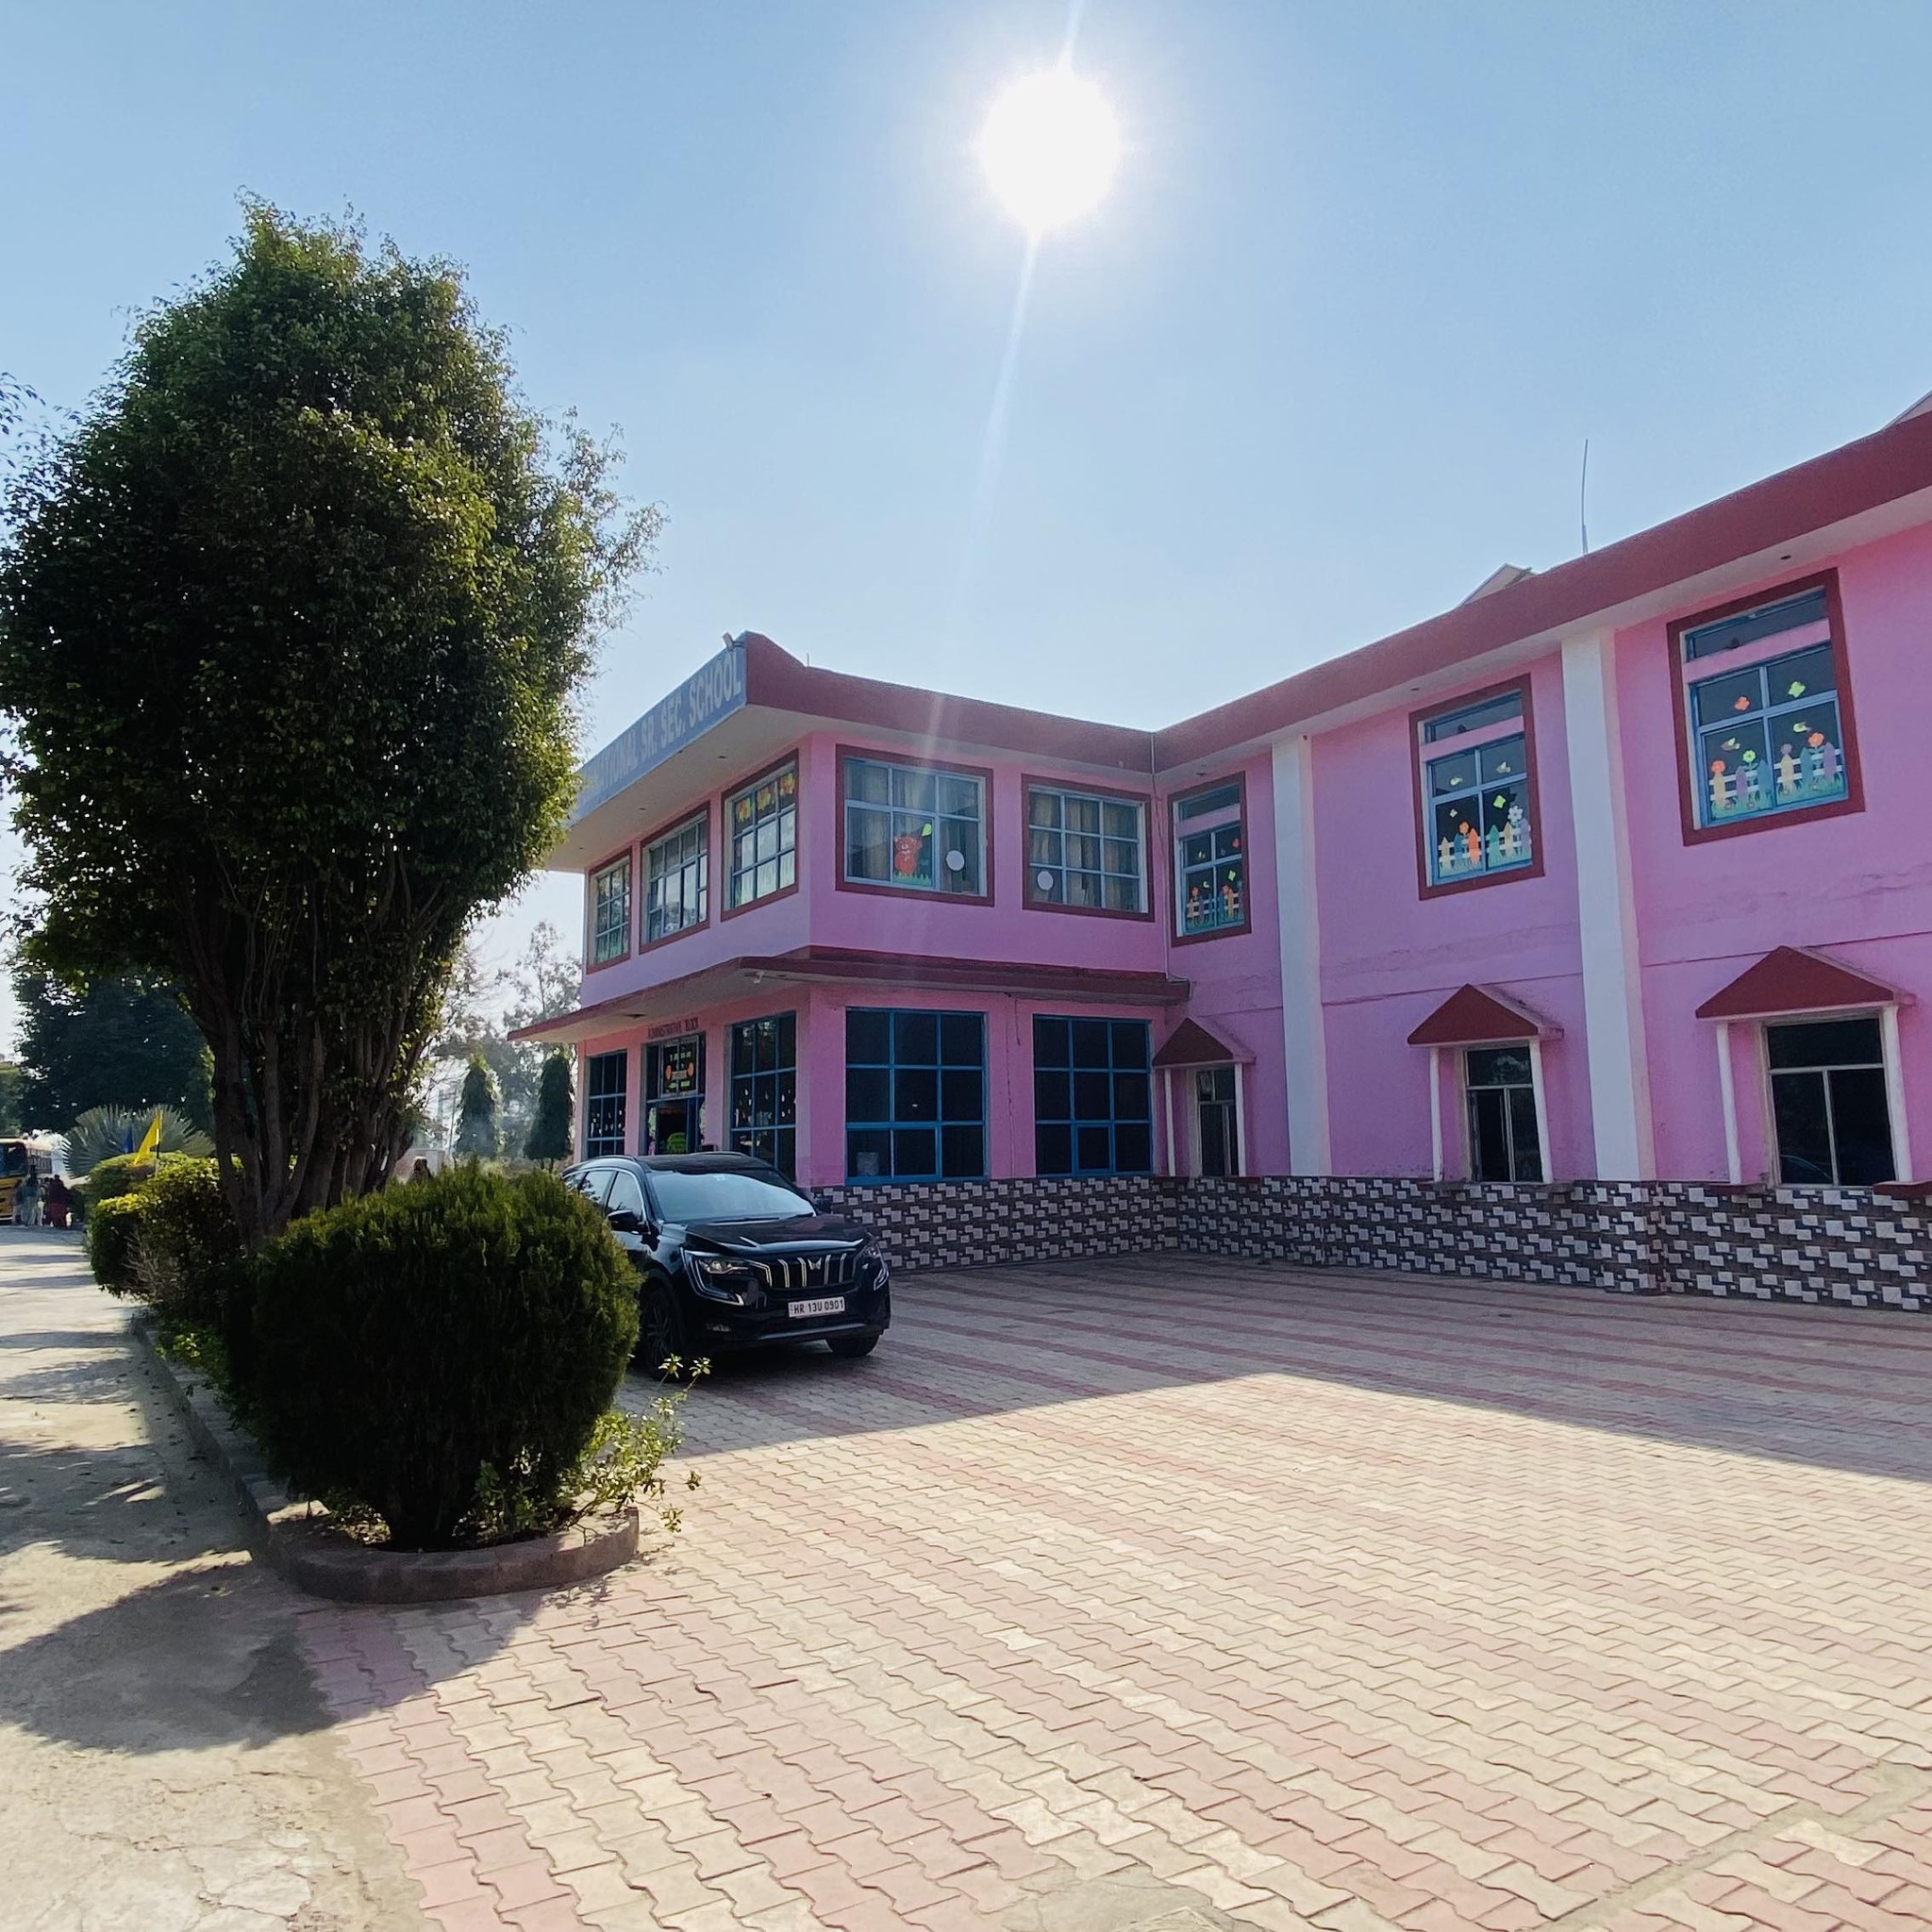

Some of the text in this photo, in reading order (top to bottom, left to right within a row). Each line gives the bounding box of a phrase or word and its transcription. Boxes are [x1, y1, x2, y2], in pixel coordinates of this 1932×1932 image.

[689, 649, 741, 728] SCHOOL
[793, 1303, 805, 1314] HR
[808, 1301, 823, 1313] 13U
